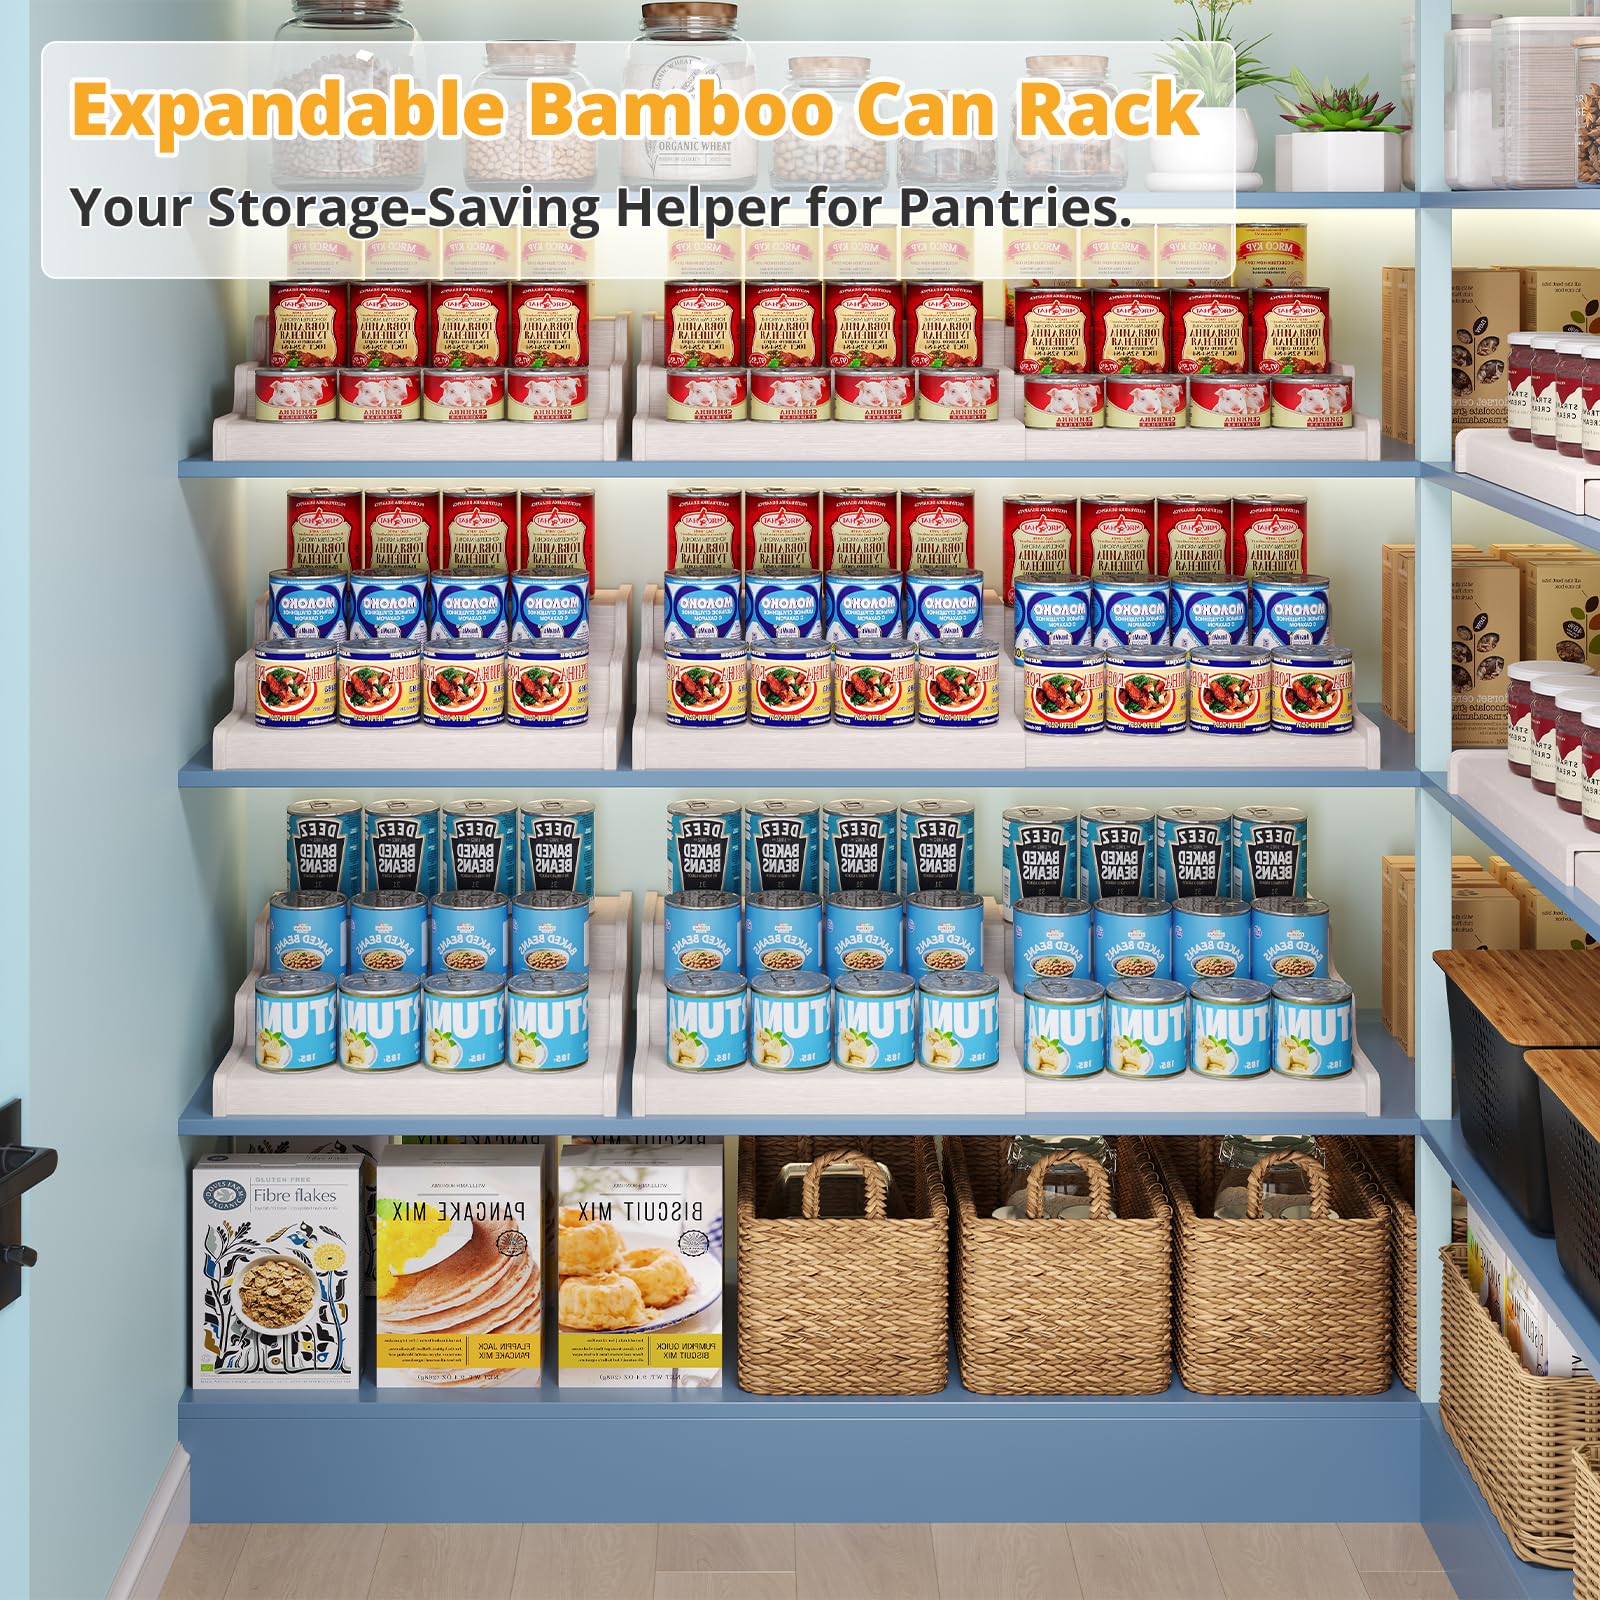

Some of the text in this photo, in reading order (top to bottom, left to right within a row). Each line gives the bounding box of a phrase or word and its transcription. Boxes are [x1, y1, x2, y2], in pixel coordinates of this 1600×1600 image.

[659, 141, 731, 151] ORGANIC WHEAT
[227, 1181, 245, 1197] FARM
[254, 1187, 337, 1202] Fibre flakes
[207, 1198, 242, 1210] ORGANIC
